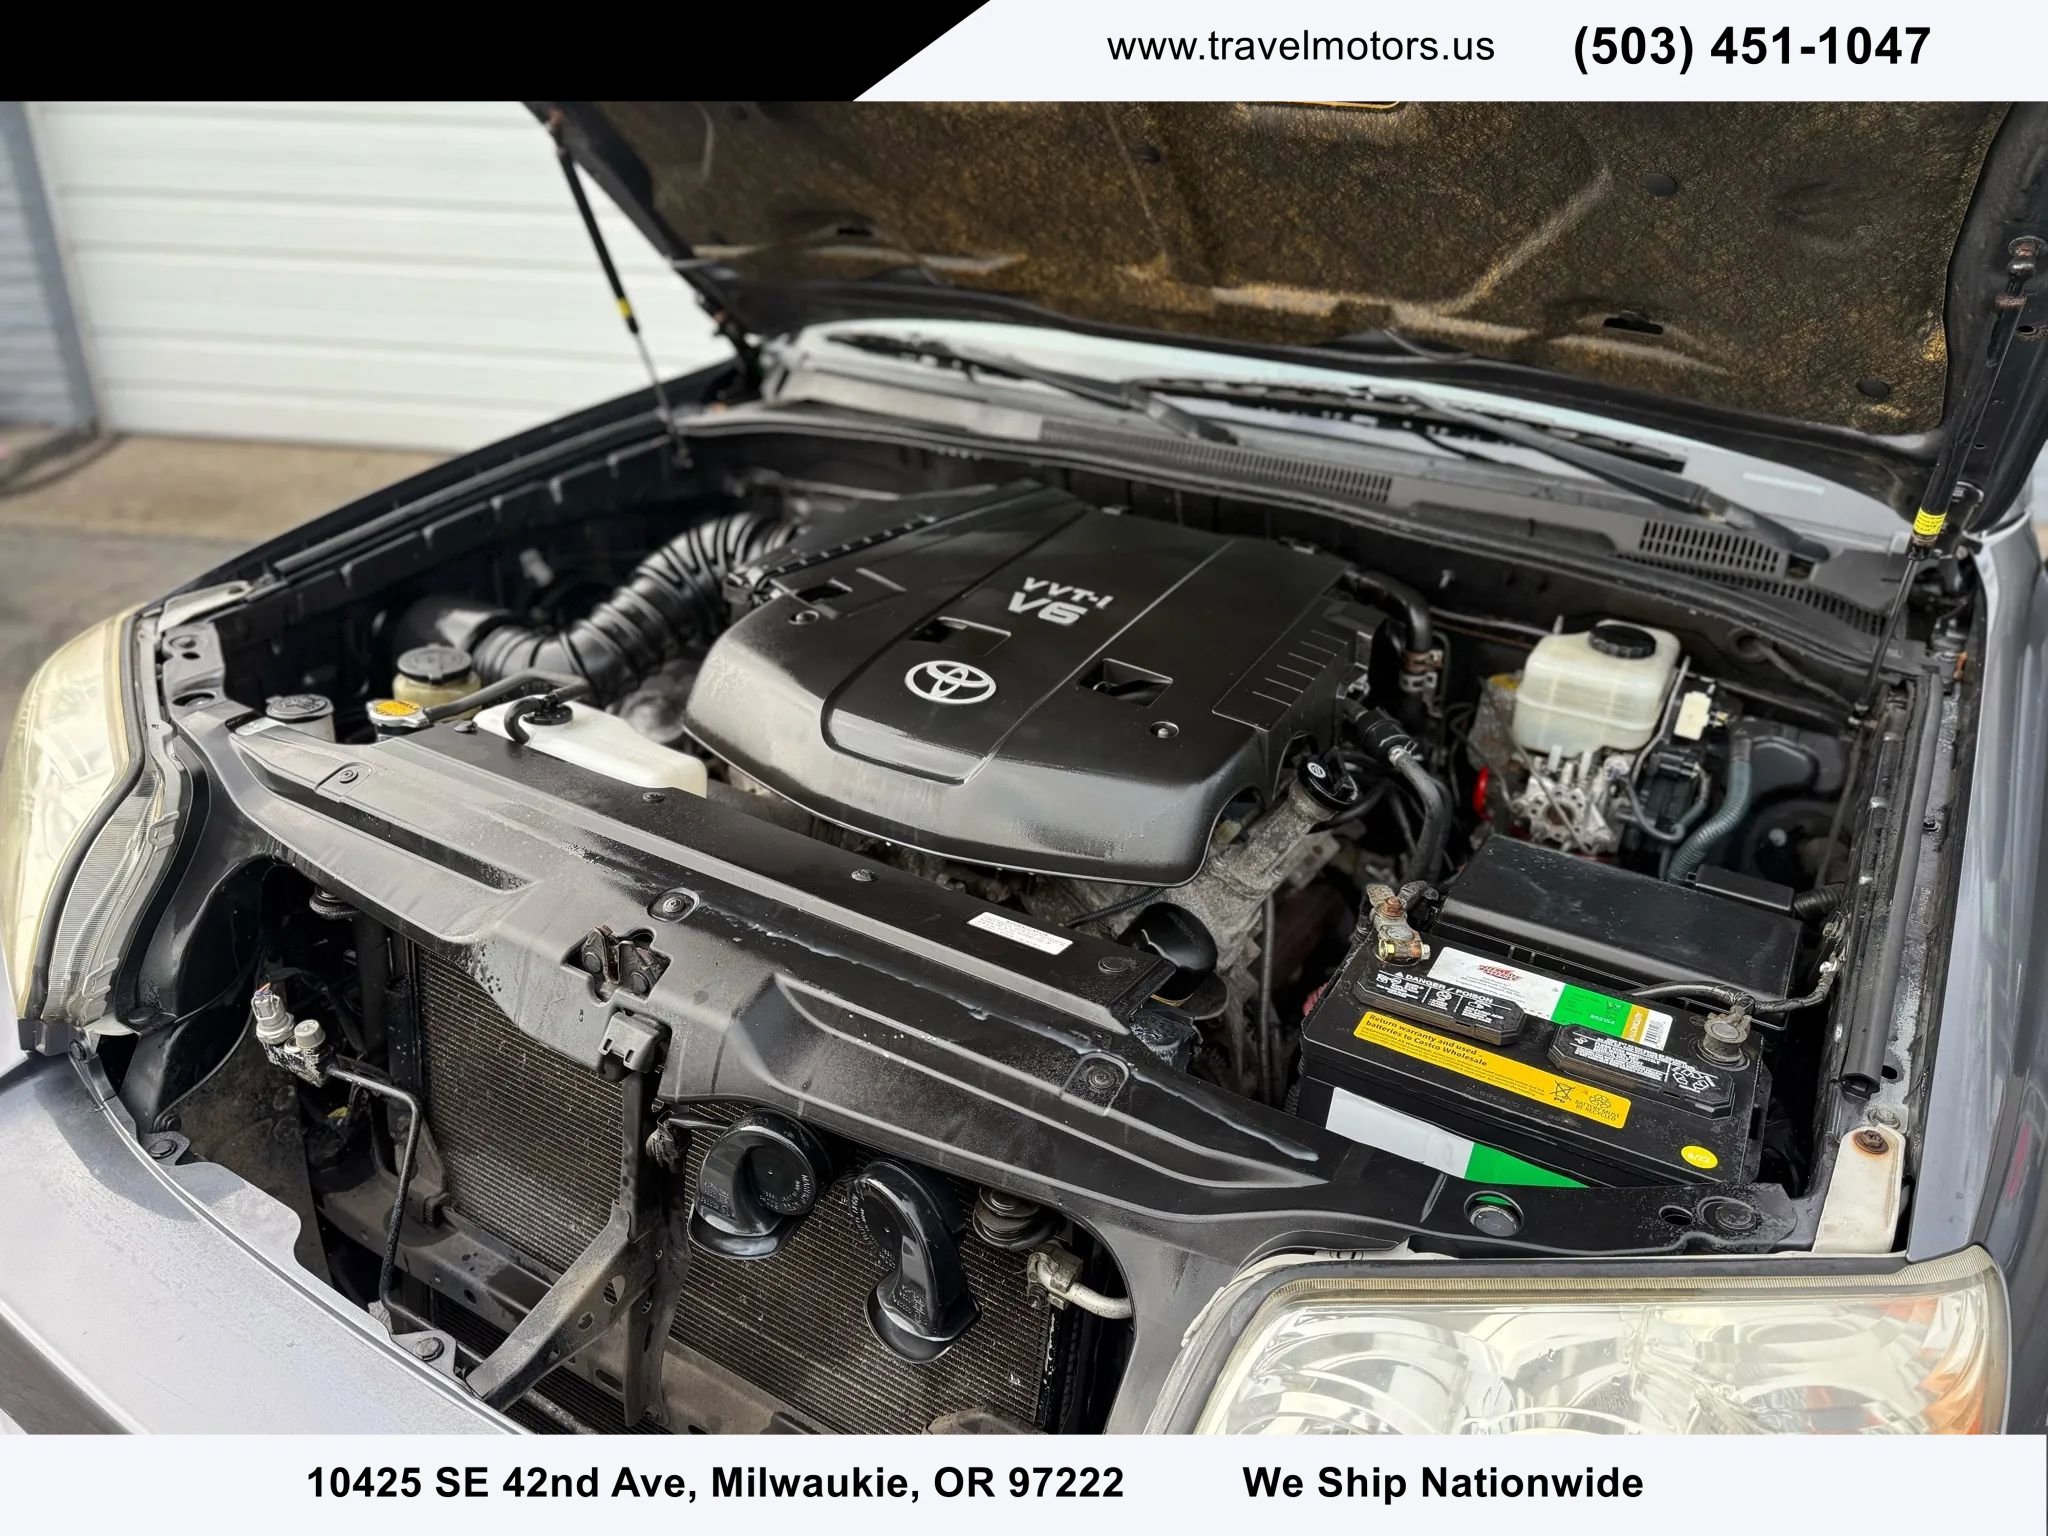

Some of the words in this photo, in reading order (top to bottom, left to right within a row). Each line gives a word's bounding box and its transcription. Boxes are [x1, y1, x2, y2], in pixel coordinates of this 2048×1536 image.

[1008, 591, 1088, 626] V6
[1405, 974, 1446, 989] DANGER
[1455, 989, 1494, 1003] POISON
[1365, 1020, 1401, 1037] batteries
[1414, 1037, 1441, 1051] Costco
[1442, 1046, 1488, 1066] Wholesale
[1369, 1014, 1397, 1028] Return
[1399, 1025, 1437, 1042] warranty
[1438, 1038, 1454, 1048] and
[1456, 1044, 1477, 1055] used
